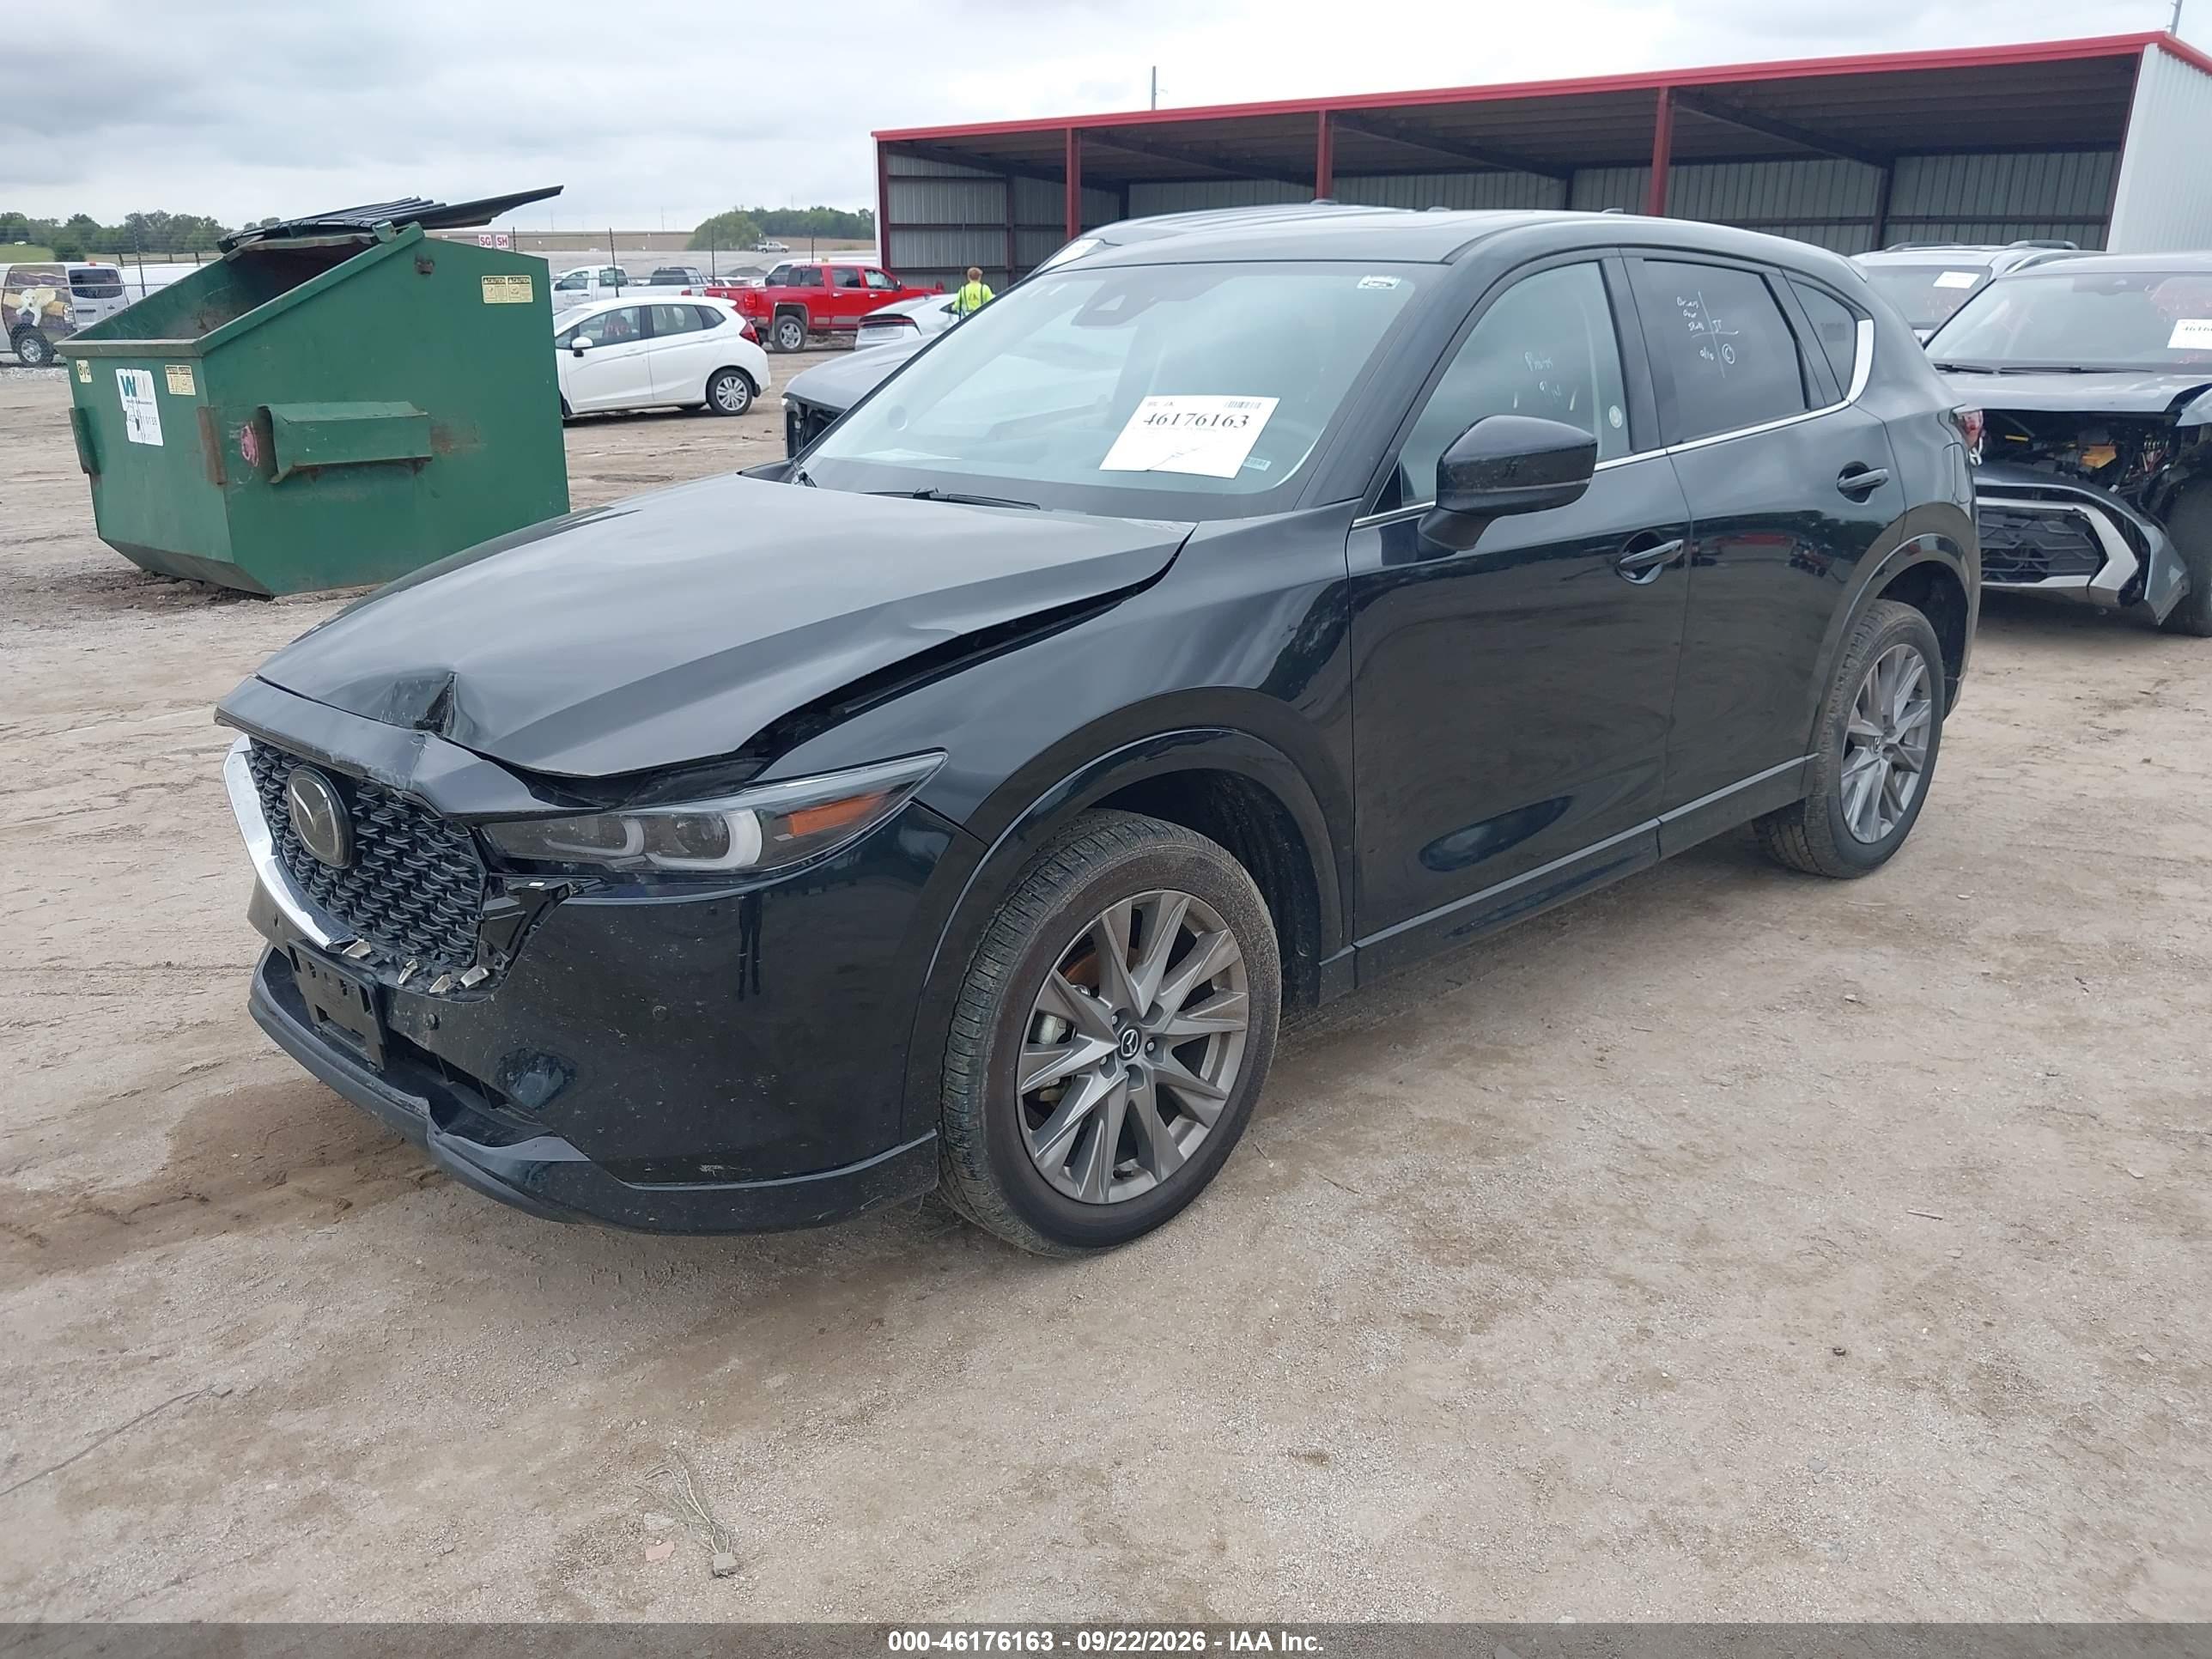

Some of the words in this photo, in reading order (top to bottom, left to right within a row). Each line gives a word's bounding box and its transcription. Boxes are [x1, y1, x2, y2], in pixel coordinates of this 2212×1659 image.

[480, 236, 491, 246] SG
[496, 236, 507, 246] SH
[1143, 412, 1249, 428] 46176163
